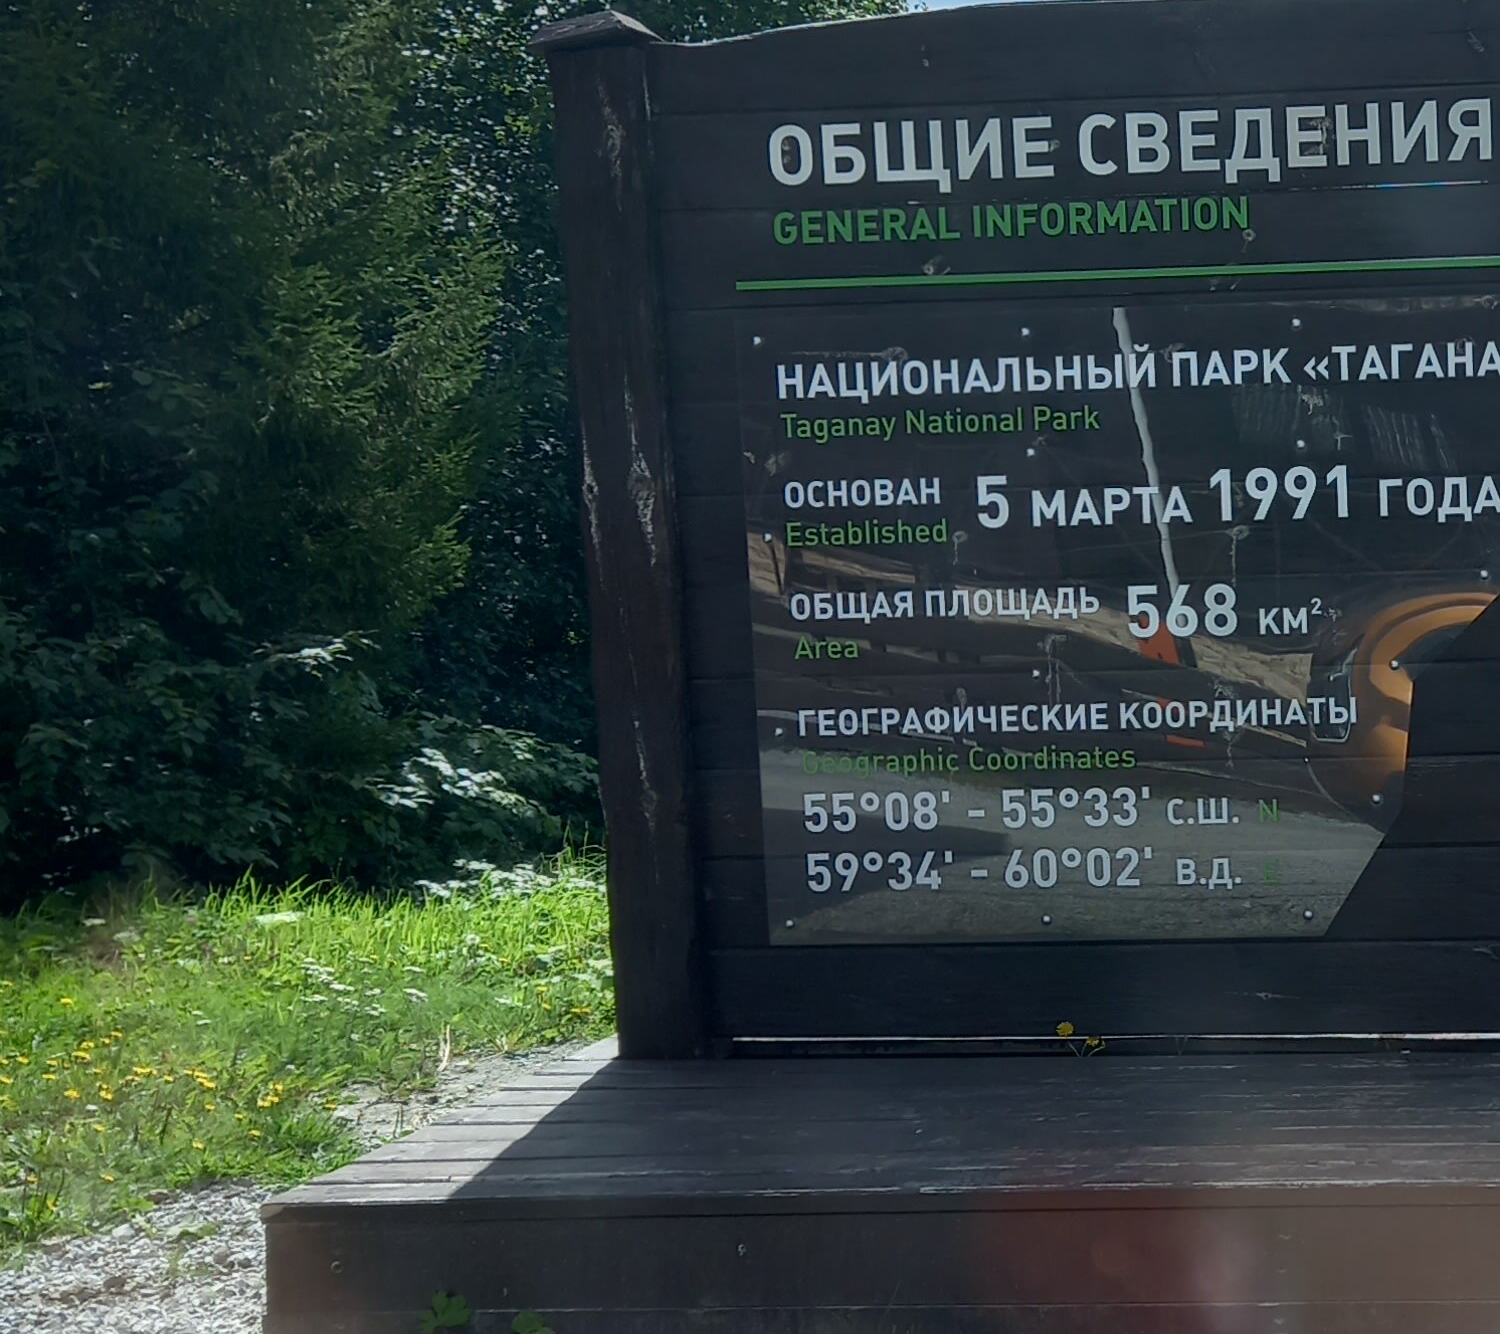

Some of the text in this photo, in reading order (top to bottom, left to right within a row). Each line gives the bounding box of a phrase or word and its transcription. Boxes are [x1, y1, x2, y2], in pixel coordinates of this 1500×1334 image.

[769, 98, 1493, 193] ОБЩИЕ СВЕДЕНИЯ
[774, 196, 1249, 245] GENERAL INFORMATION
[776, 344, 1157, 404] НАЦИОНАЛЬНЫЙ
[1172, 347, 1291, 388] ПАРК
[780, 404, 1100, 444] Taganay National Park
[784, 477, 941, 509] ОСНОВАН
[976, 475, 1009, 528] 5
[1032, 484, 1193, 527] МАРТА
[1209, 464, 1349, 522] 1991
[786, 518, 948, 547] Established
[790, 591, 914, 624] ОБЩАЯ
[925, 586, 1100, 620] ПЛОЩАДЬ
[1127, 583, 1238, 637] 568
[795, 637, 858, 659] Area
[798, 697, 1357, 736] ГЕОГРАФИЧЕСКИЕ КООРДИНАТЫ
[802, 745, 1136, 778] Geographic Coordinates
[803, 791, 950, 833] 55°08'
[1002, 786, 1150, 828] 55°33'
[1258, 799, 1278, 822] N
[806, 851, 953, 892] 59°34'
[1005, 846, 1152, 888] 60°02'
[1263, 859, 1278, 884] E
